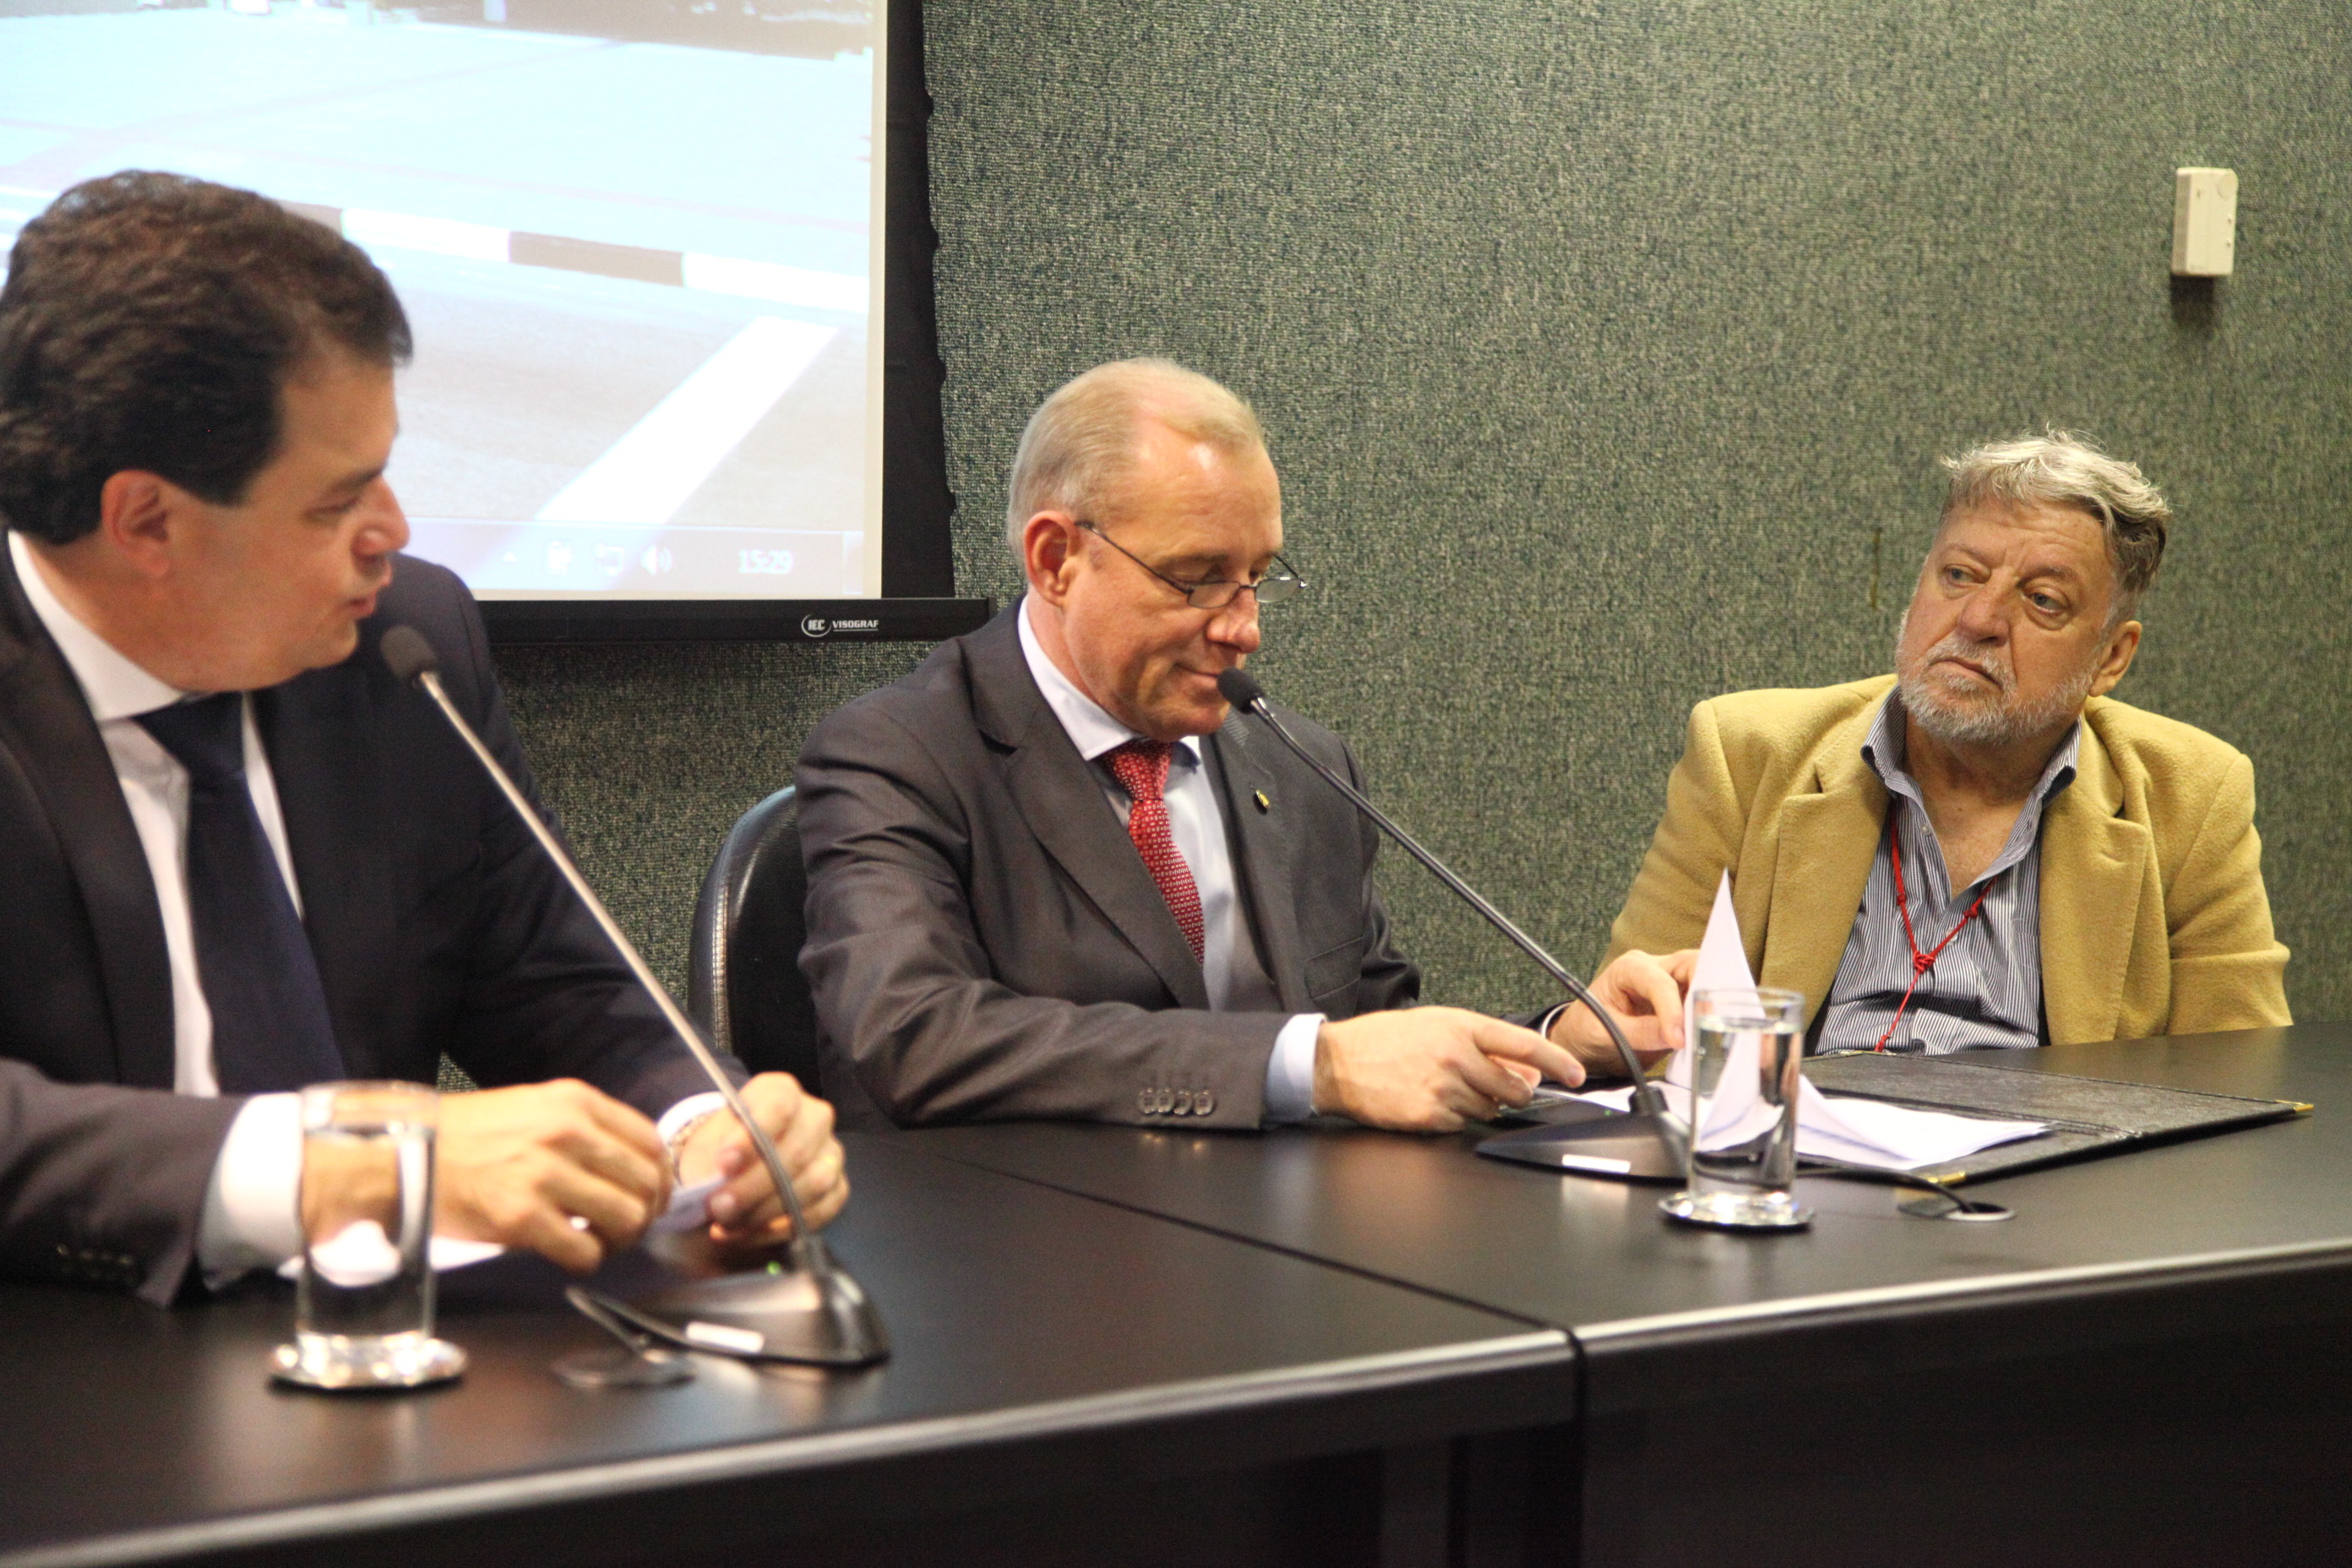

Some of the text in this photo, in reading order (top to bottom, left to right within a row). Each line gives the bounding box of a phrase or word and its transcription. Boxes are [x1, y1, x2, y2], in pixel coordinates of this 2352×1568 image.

[738, 550, 792, 574] 15:29
[808, 619, 879, 630] IEC VISOGRAF
